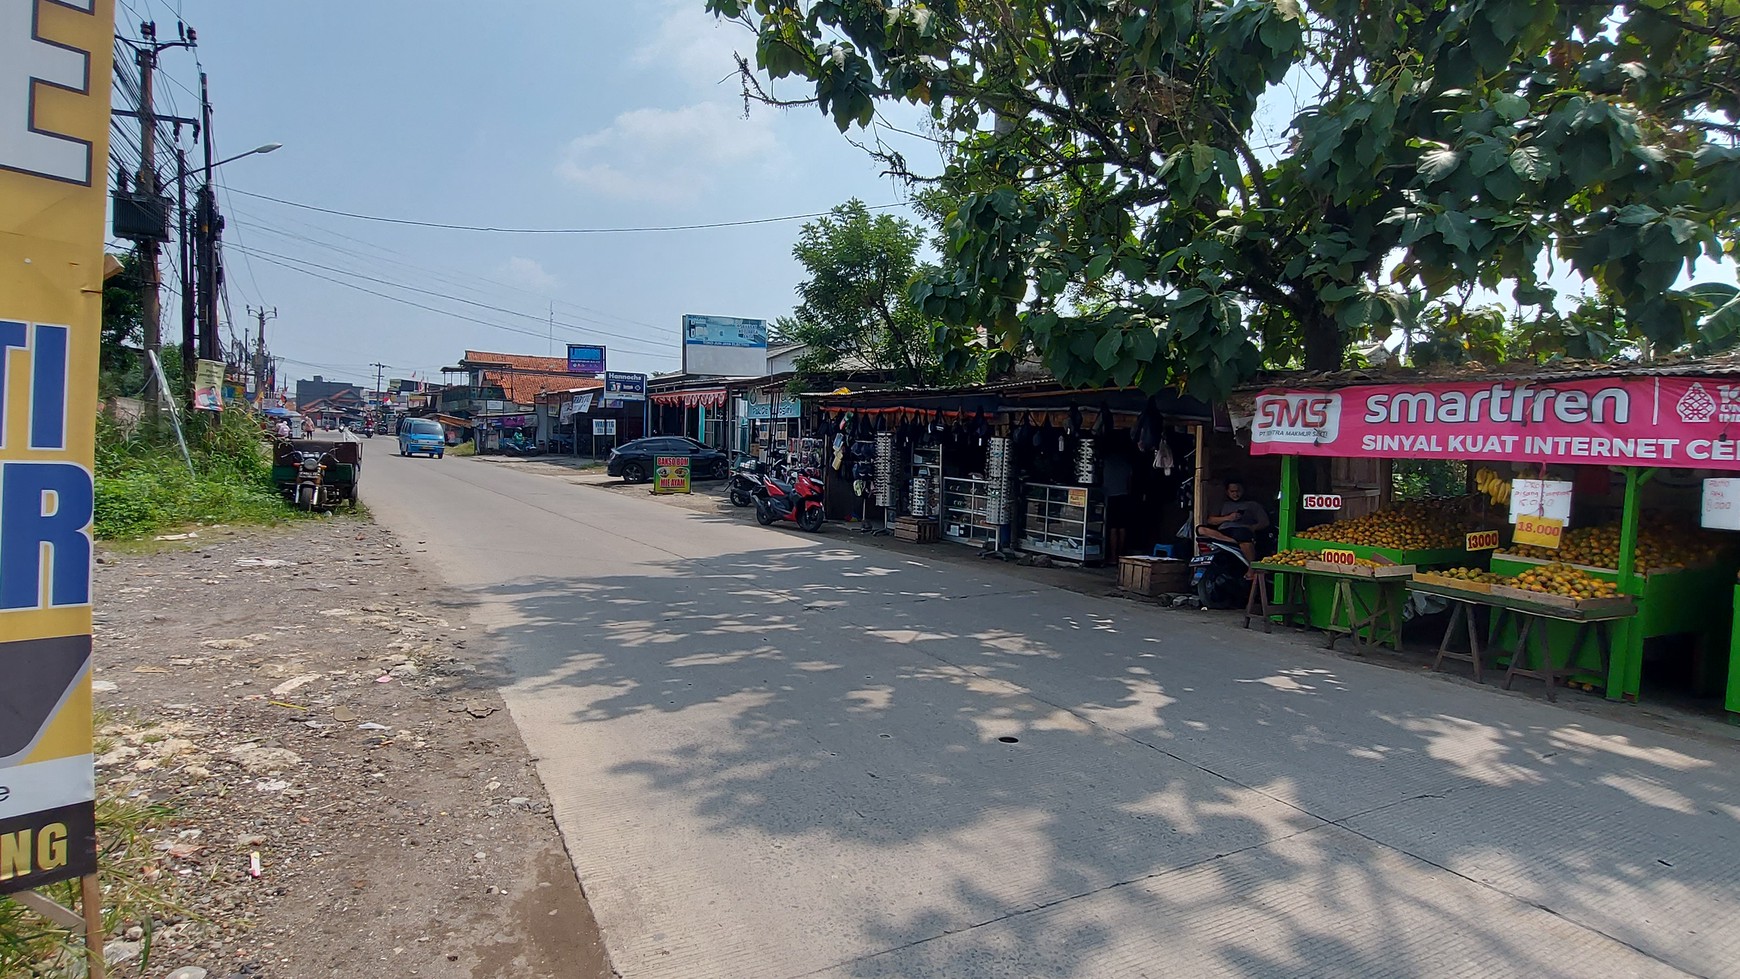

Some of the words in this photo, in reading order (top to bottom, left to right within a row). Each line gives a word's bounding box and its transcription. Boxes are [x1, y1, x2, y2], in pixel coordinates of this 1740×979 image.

[1364, 382, 1629, 424] smartfren
[1258, 398, 1332, 428] SMS
[1361, 435, 1442, 452] SINYAL
[1448, 435, 1519, 453] KUAT
[1524, 437, 1680, 459] INTERNET
[1686, 439, 1740, 461] CE
[670, 478, 686, 487] AYAM
[1304, 496, 1341, 508] 15000
[1518, 521, 1560, 537] 18.000
[1468, 532, 1498, 549] 13000
[1322, 551, 1354, 565] 10000
